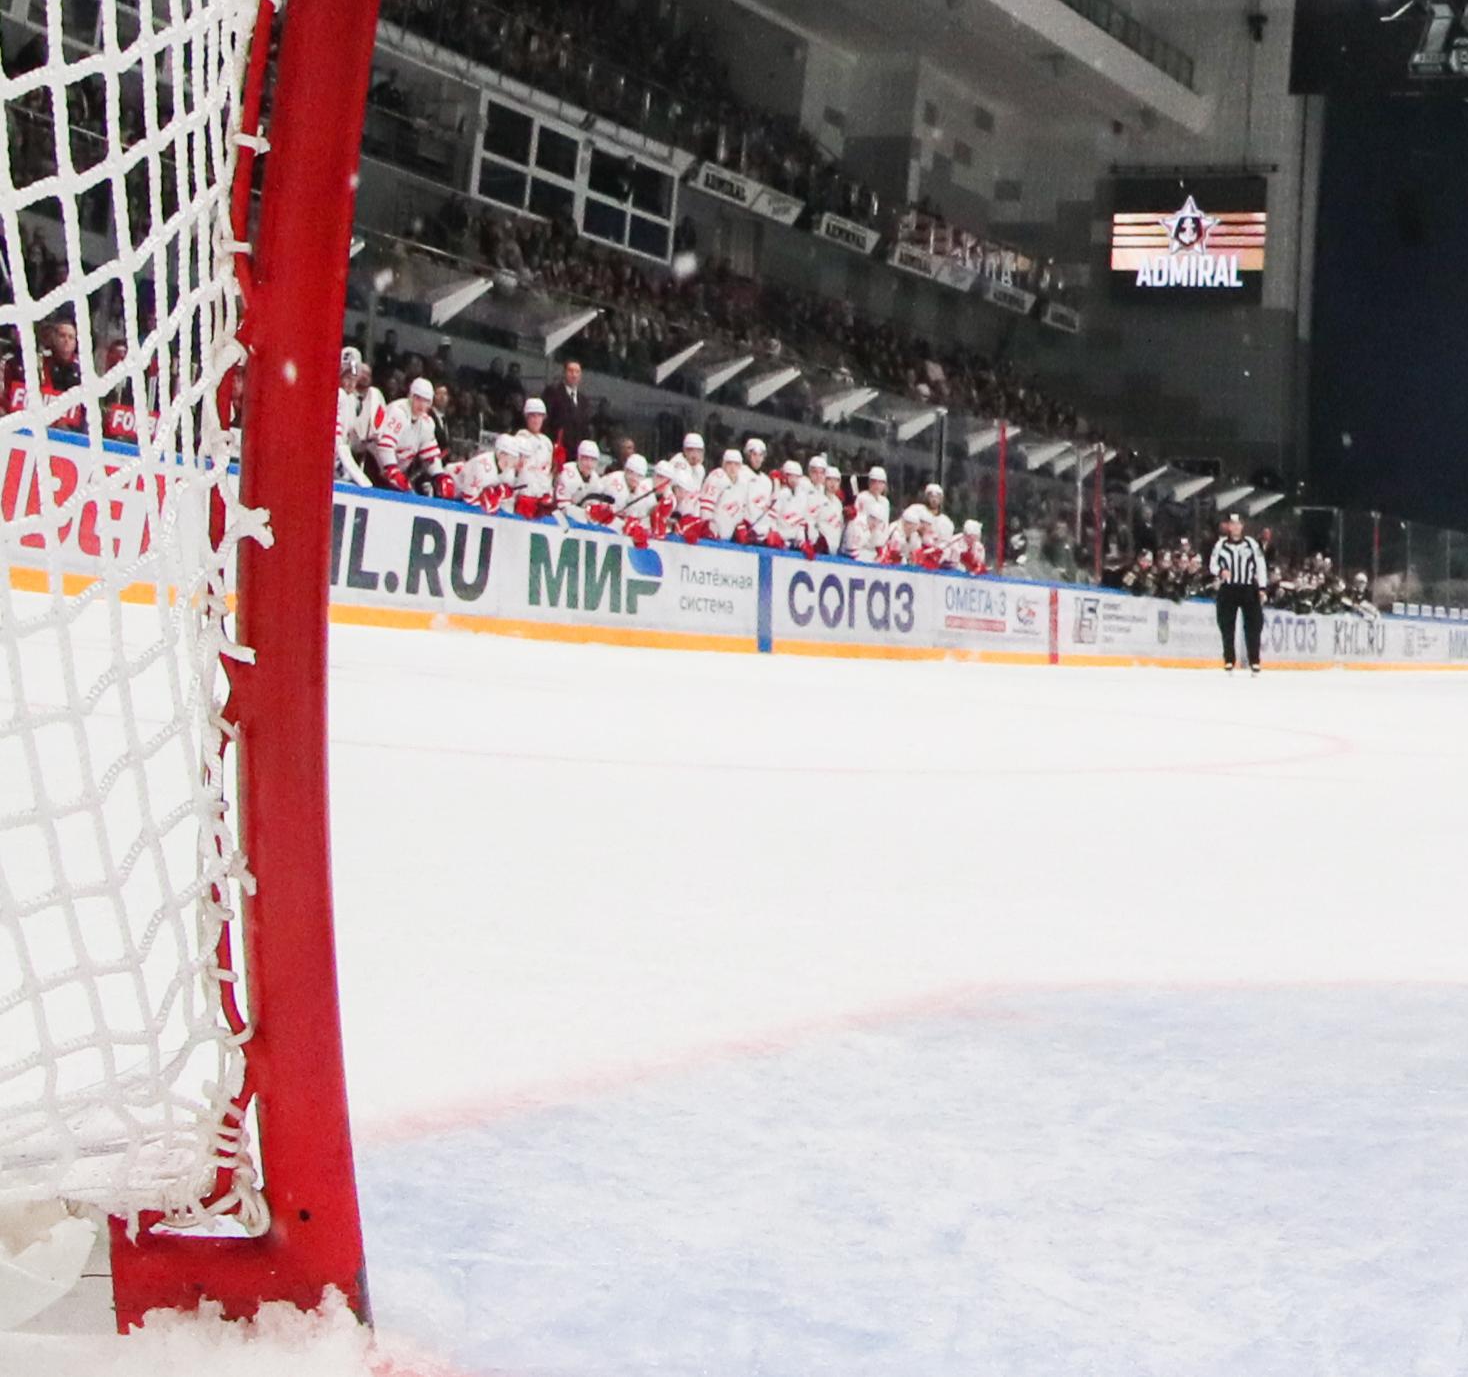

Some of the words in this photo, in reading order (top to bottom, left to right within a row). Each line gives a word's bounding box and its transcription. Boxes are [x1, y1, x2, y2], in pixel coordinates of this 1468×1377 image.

[1136, 254, 1244, 288] ADMIRAL
[529, 532, 664, 615] МИР
[680, 564, 753, 591] Платёжная
[680, 596, 734, 615] система
[945, 584, 1007, 617] ОМЕГА-3
